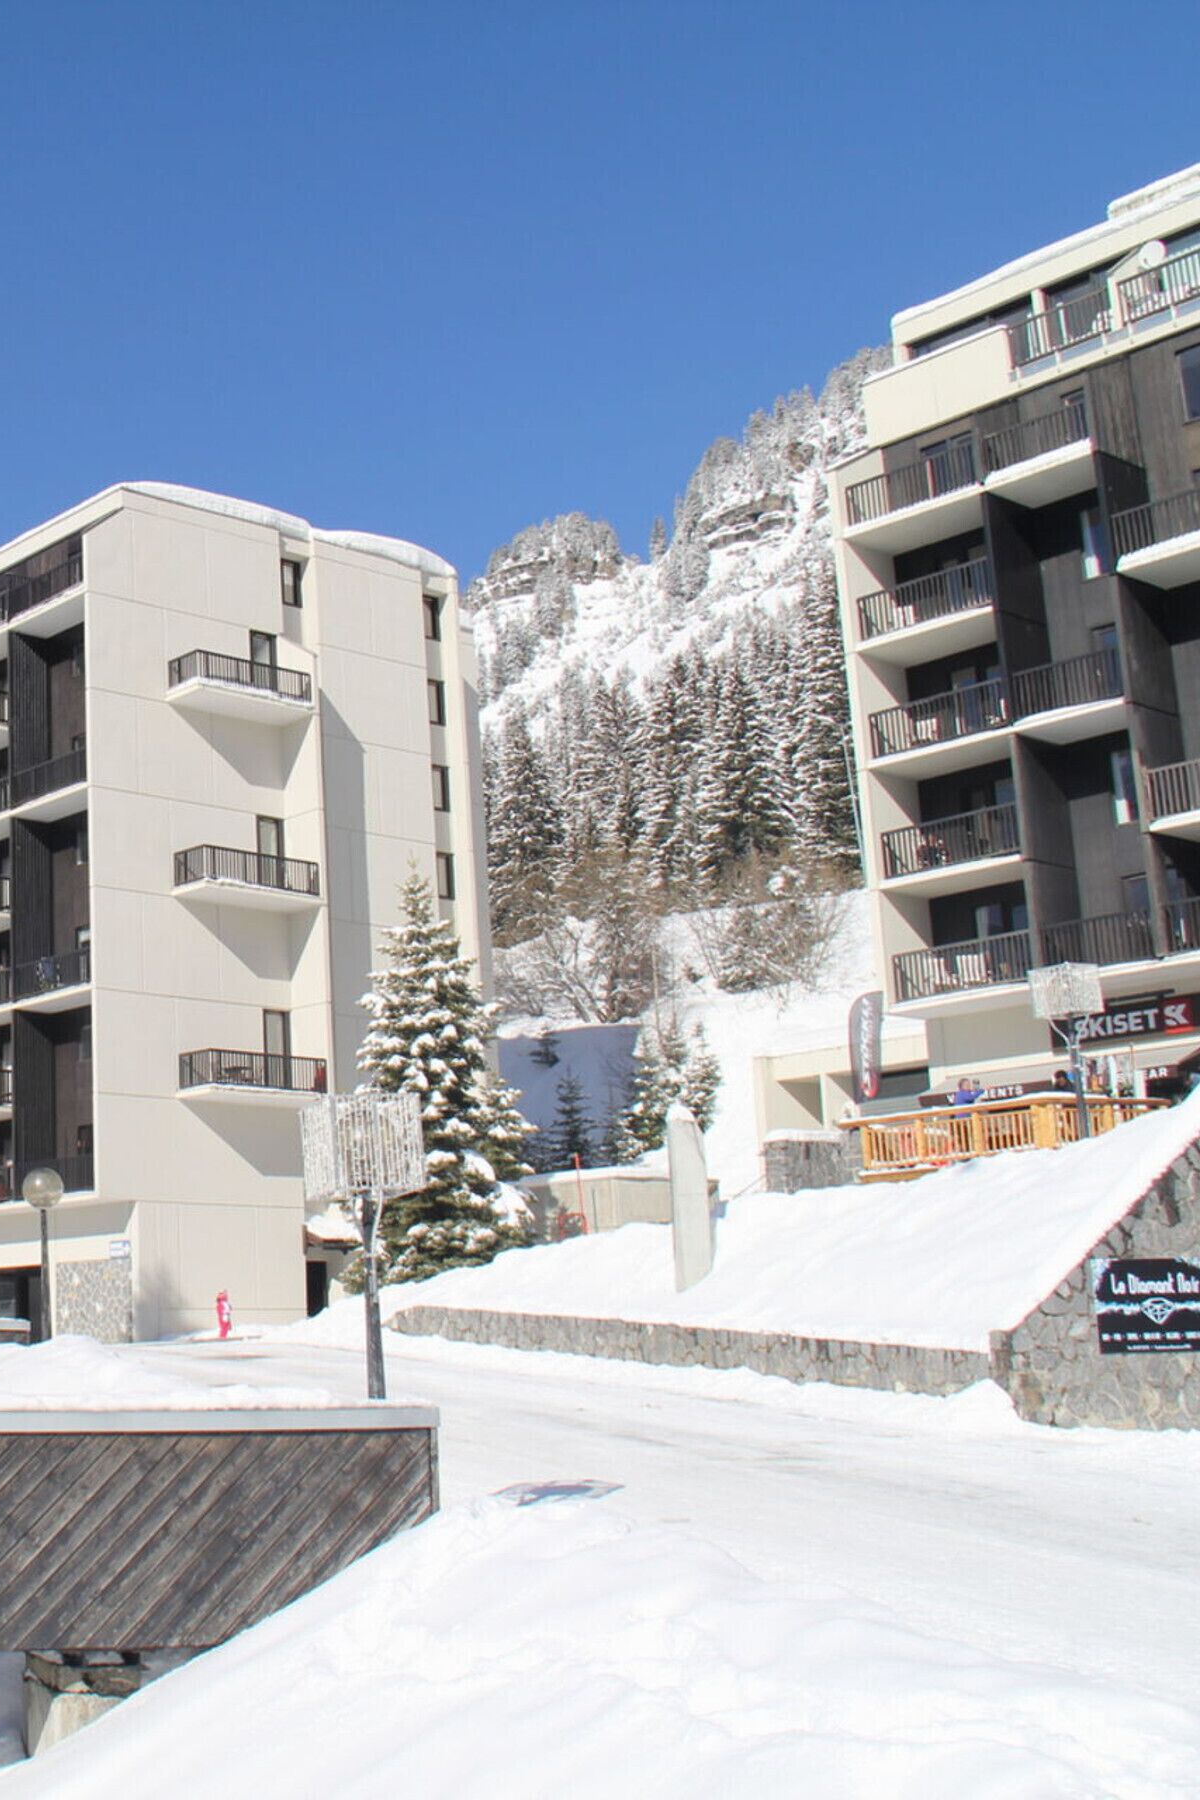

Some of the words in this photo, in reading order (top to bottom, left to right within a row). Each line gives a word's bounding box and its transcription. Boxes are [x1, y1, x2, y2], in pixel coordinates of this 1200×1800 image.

[1074, 1008, 1159, 1039] SKISET
[1110, 1273, 1126, 1295] Le
[1127, 1272, 1175, 1294] Diamant
